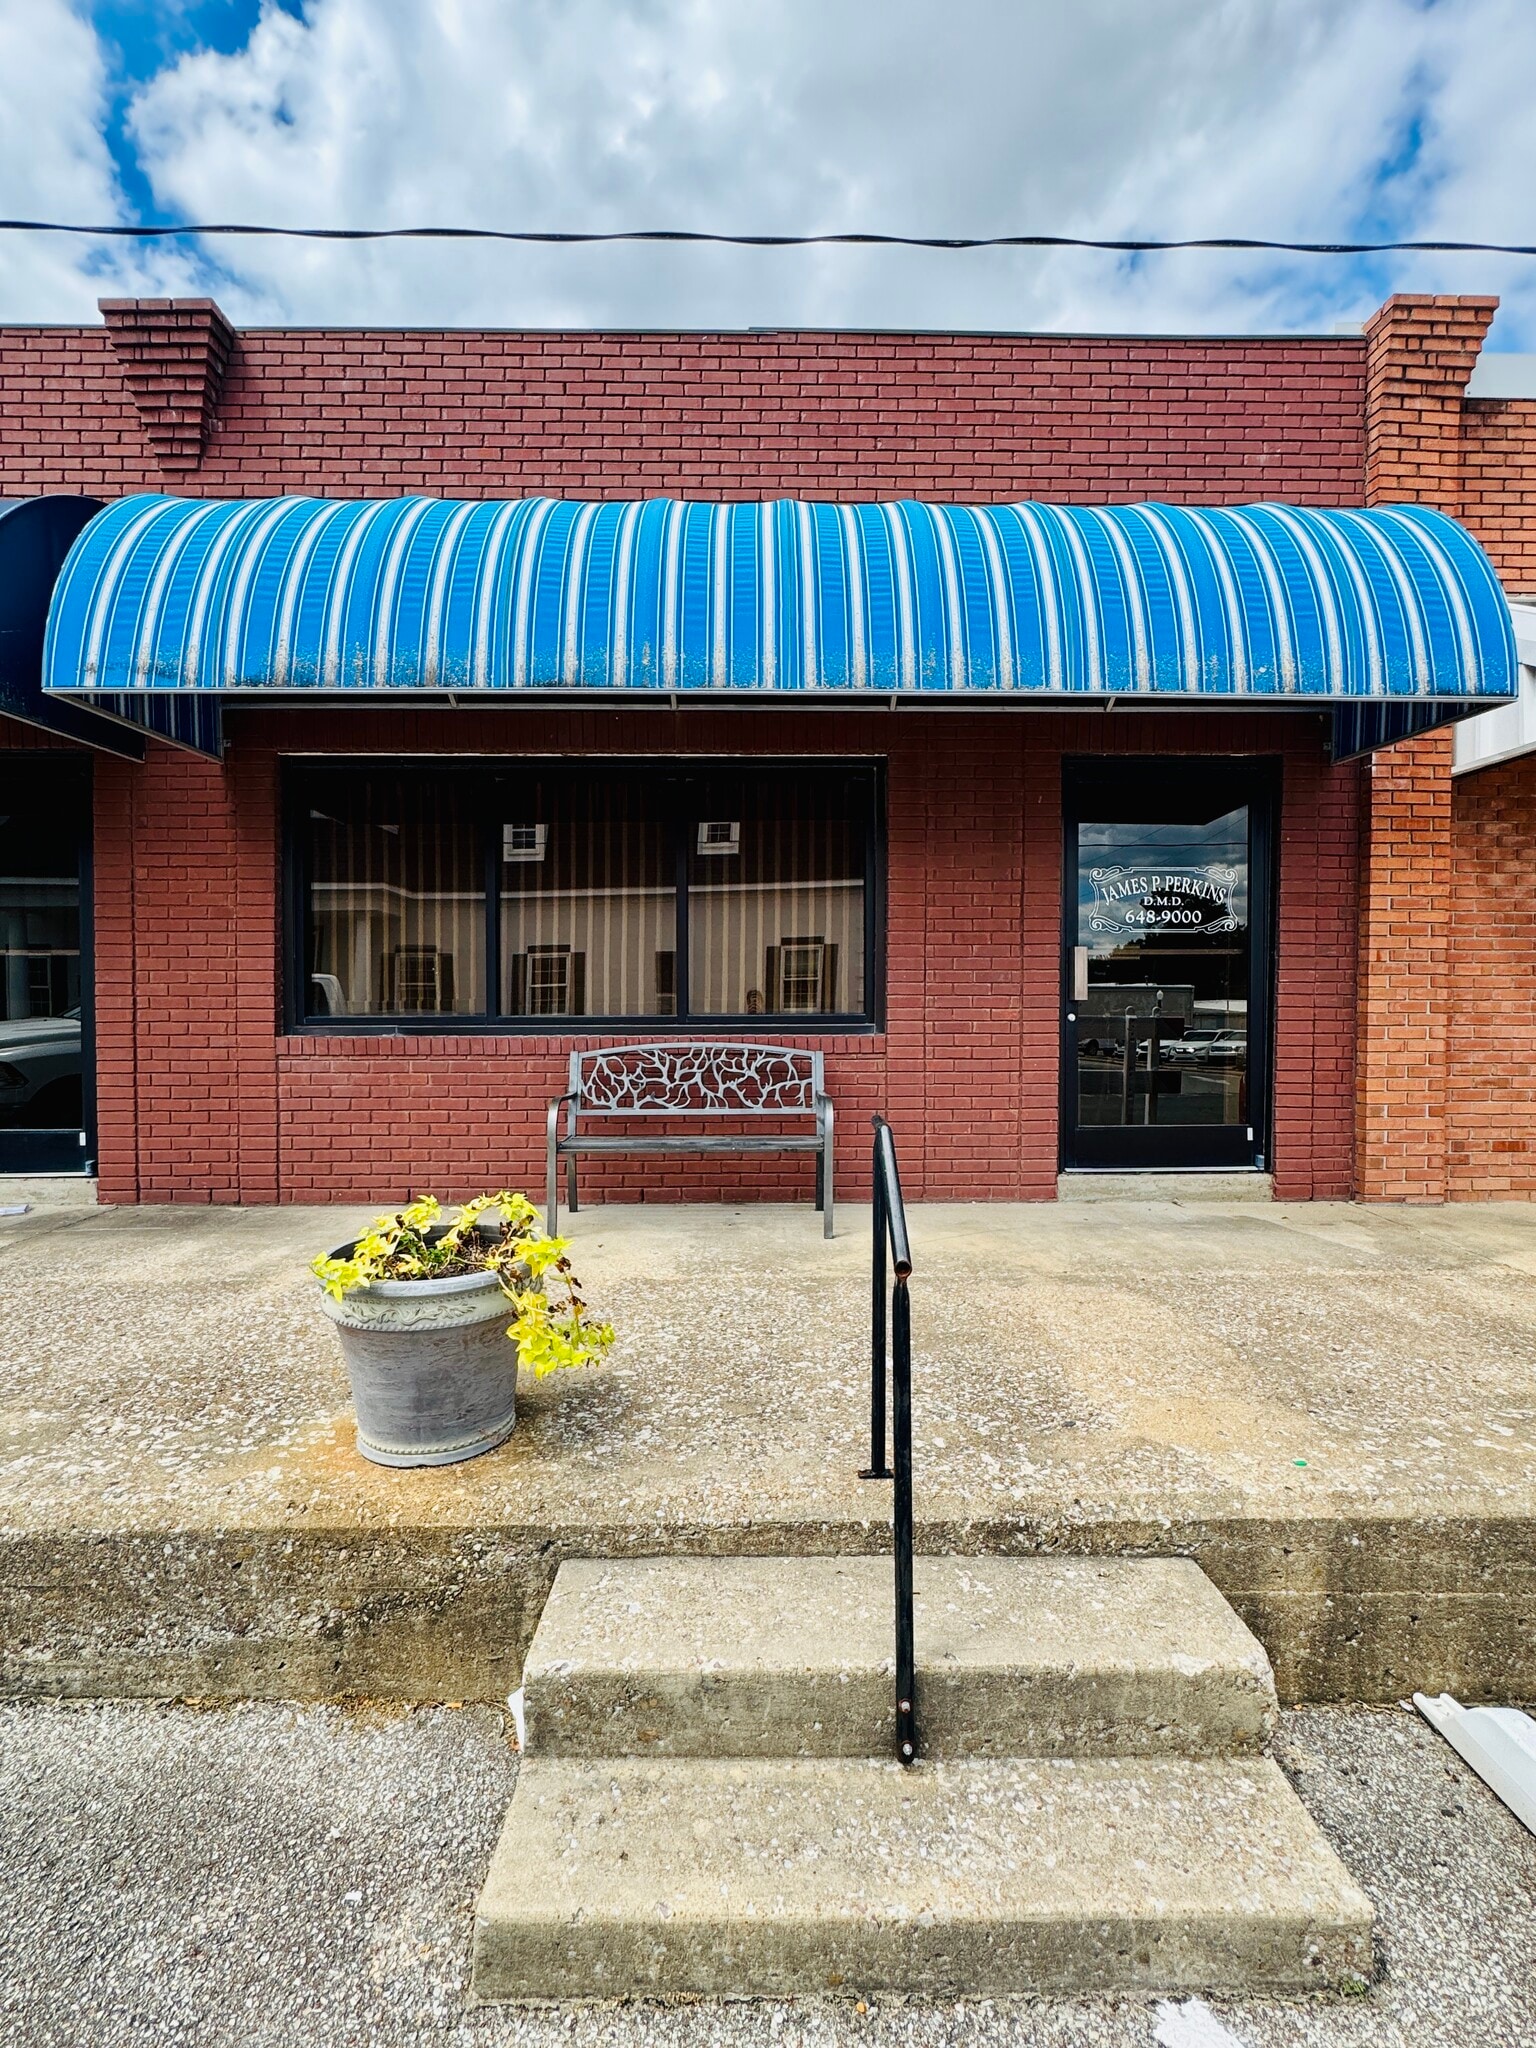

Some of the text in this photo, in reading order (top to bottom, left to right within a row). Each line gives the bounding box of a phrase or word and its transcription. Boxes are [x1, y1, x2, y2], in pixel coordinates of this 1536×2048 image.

[1101, 875, 1227, 906] JAMES P. PERKINS
[1143, 896, 1185, 906] D.M.D.
[1125, 909, 1202, 924] 648-9000
